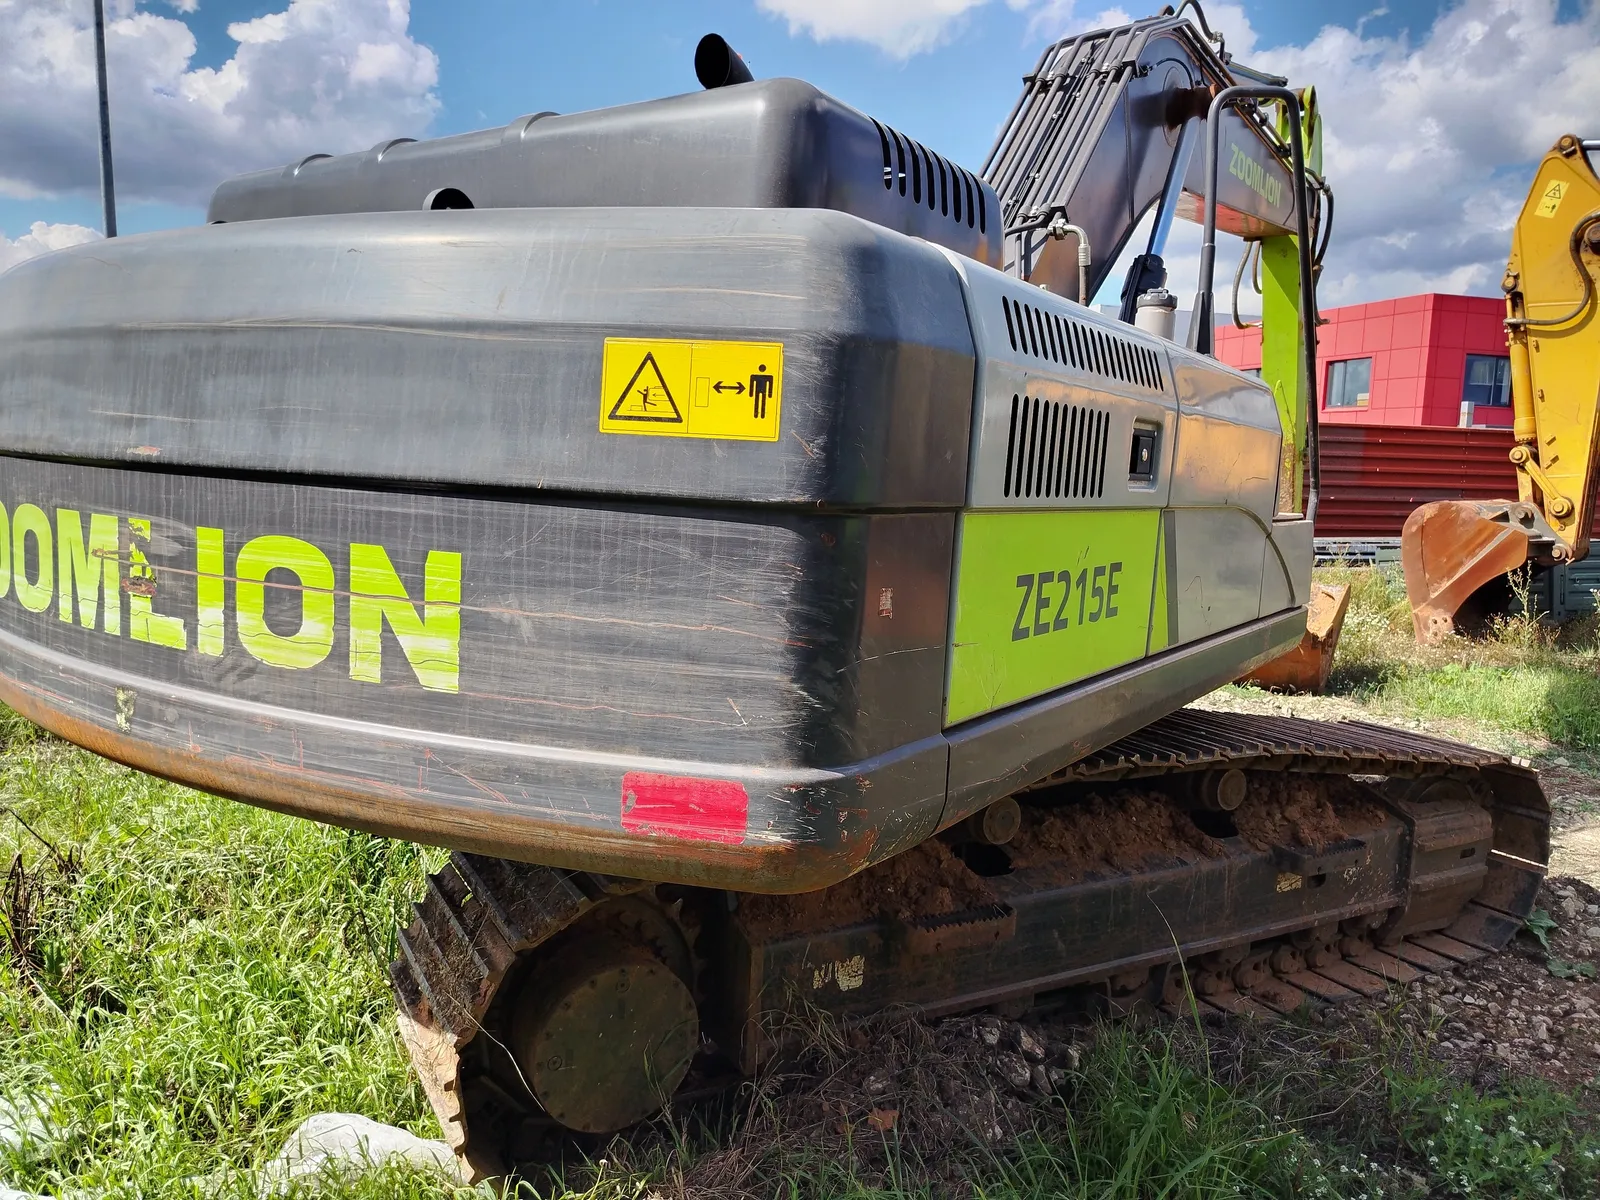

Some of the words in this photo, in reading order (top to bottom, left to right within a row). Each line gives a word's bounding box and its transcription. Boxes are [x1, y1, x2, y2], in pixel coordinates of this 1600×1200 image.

[1229, 143, 1281, 208] ZOOMLION
[0, 499, 462, 694] OMLION
[1011, 562, 1123, 642] ZE215E
